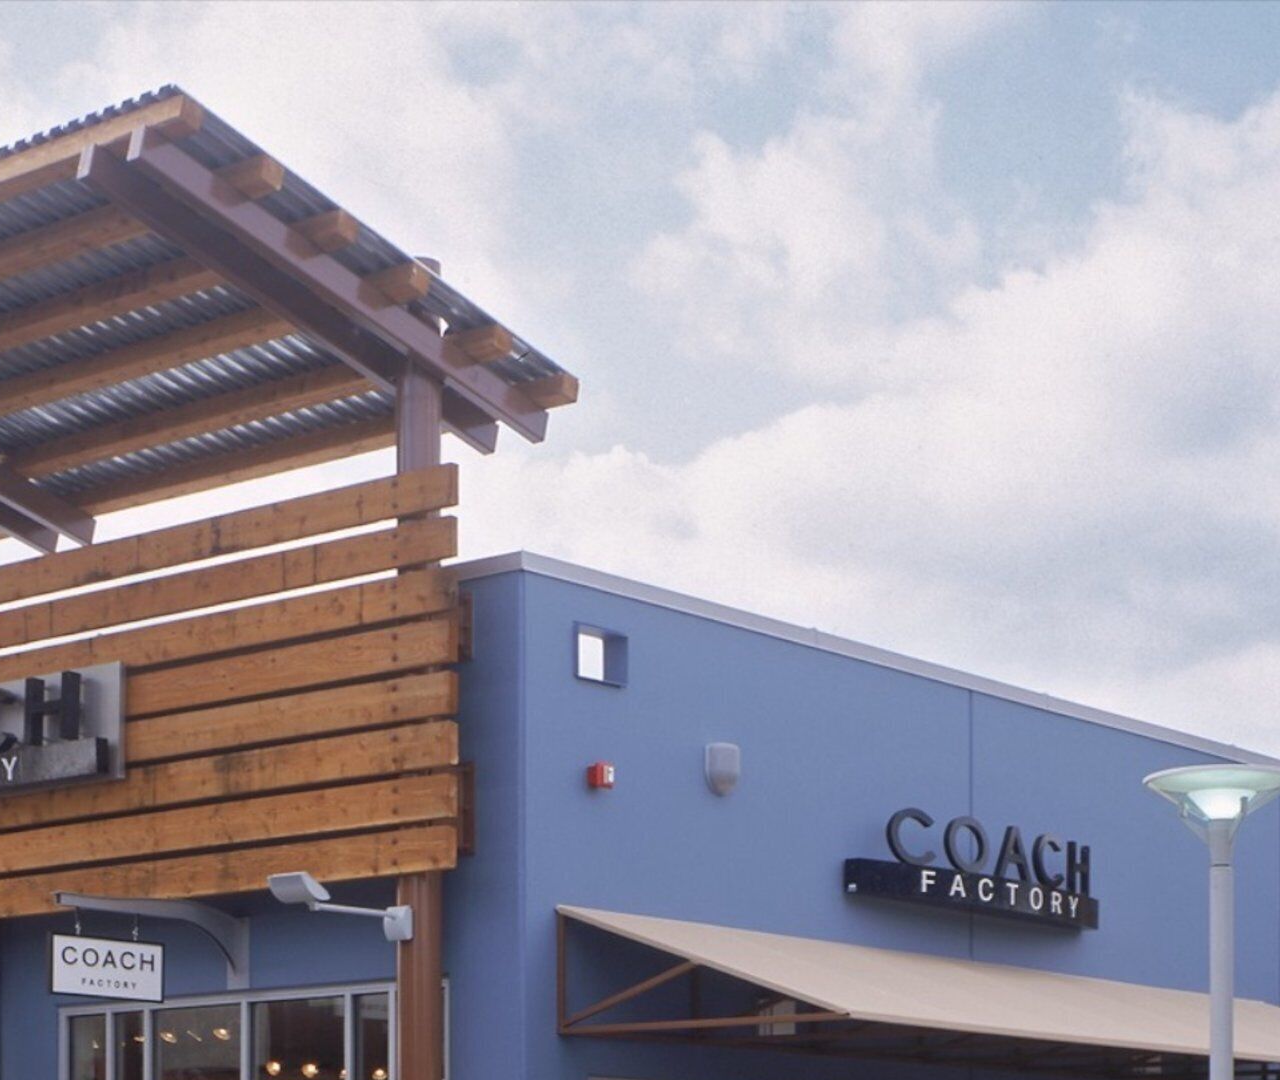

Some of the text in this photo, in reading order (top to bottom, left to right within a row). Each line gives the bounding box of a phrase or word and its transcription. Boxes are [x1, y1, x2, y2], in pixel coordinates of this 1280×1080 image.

[885, 807, 1091, 898] COACH
[920, 869, 1080, 918] FACTORY
[61, 945, 155, 972] COACH
[81, 977, 138, 990] FACTORY
